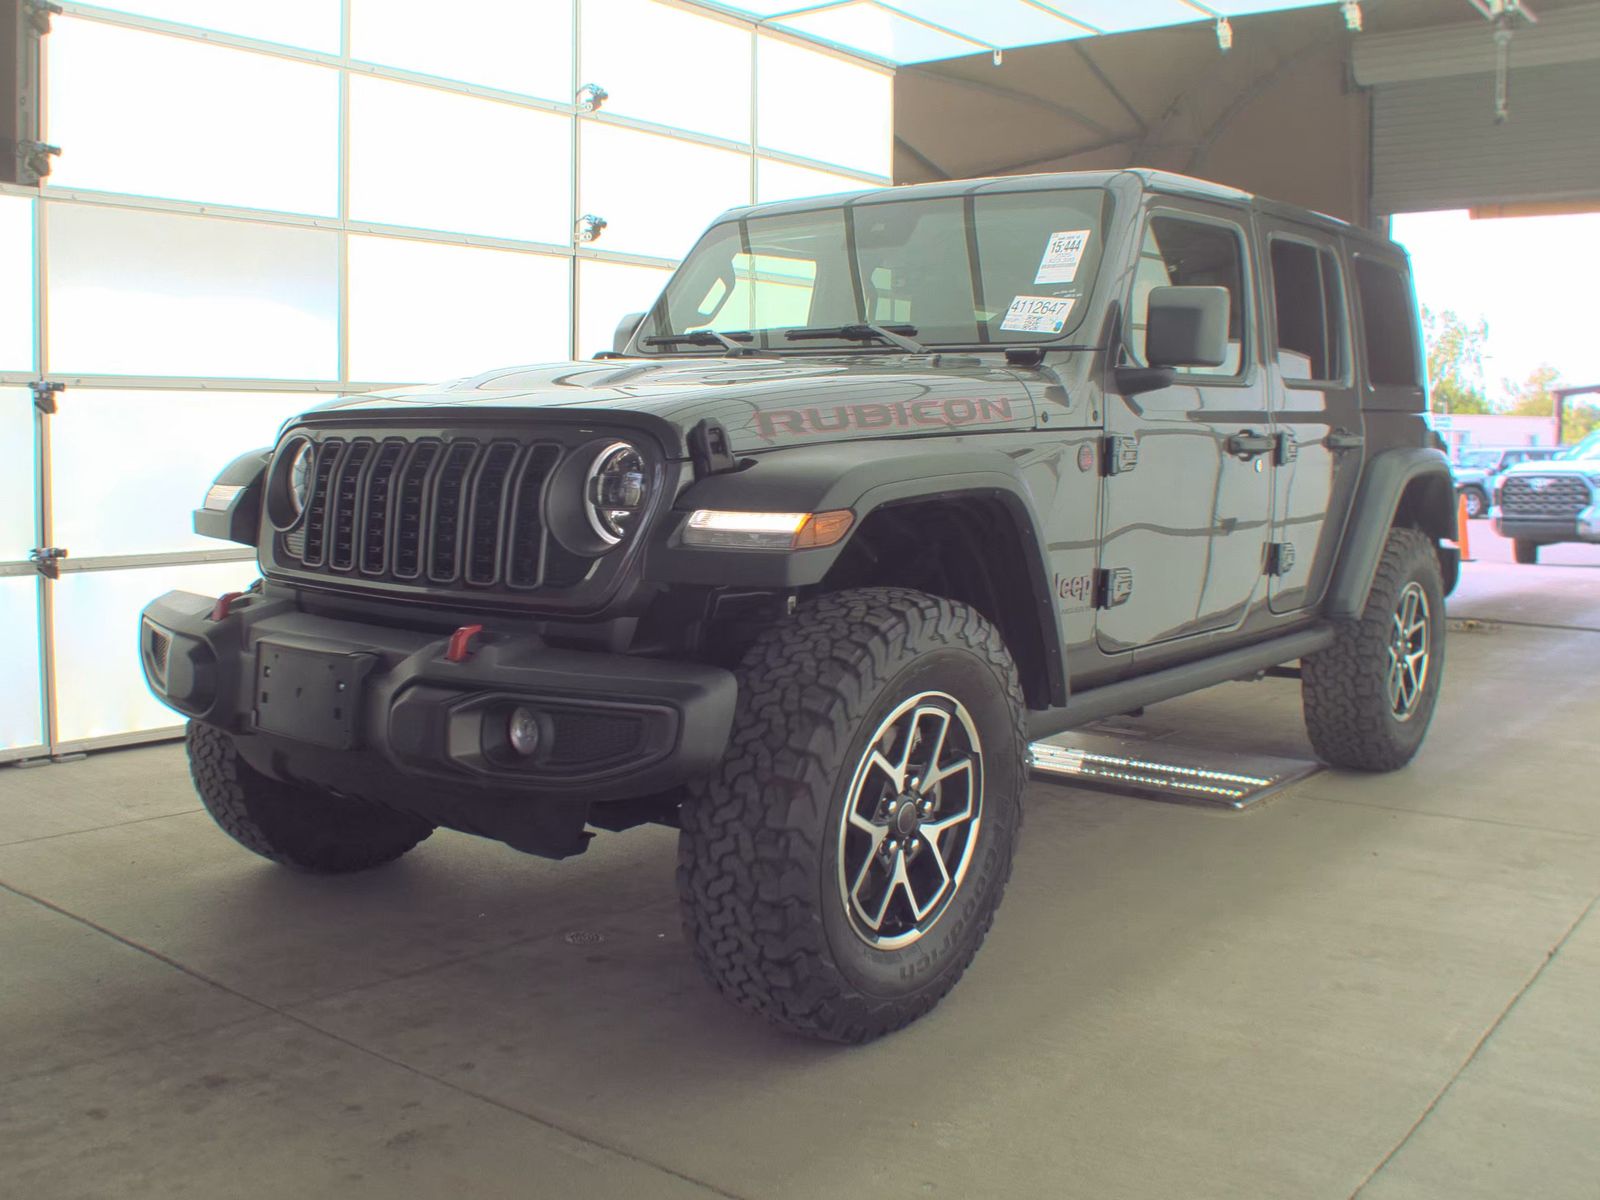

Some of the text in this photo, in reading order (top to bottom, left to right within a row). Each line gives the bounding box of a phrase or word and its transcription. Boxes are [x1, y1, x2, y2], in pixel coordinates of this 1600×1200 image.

[1010, 301, 1067, 315] 4112647
[755, 397, 1013, 438] RUBICON
[1055, 573, 1091, 601] Jeep
